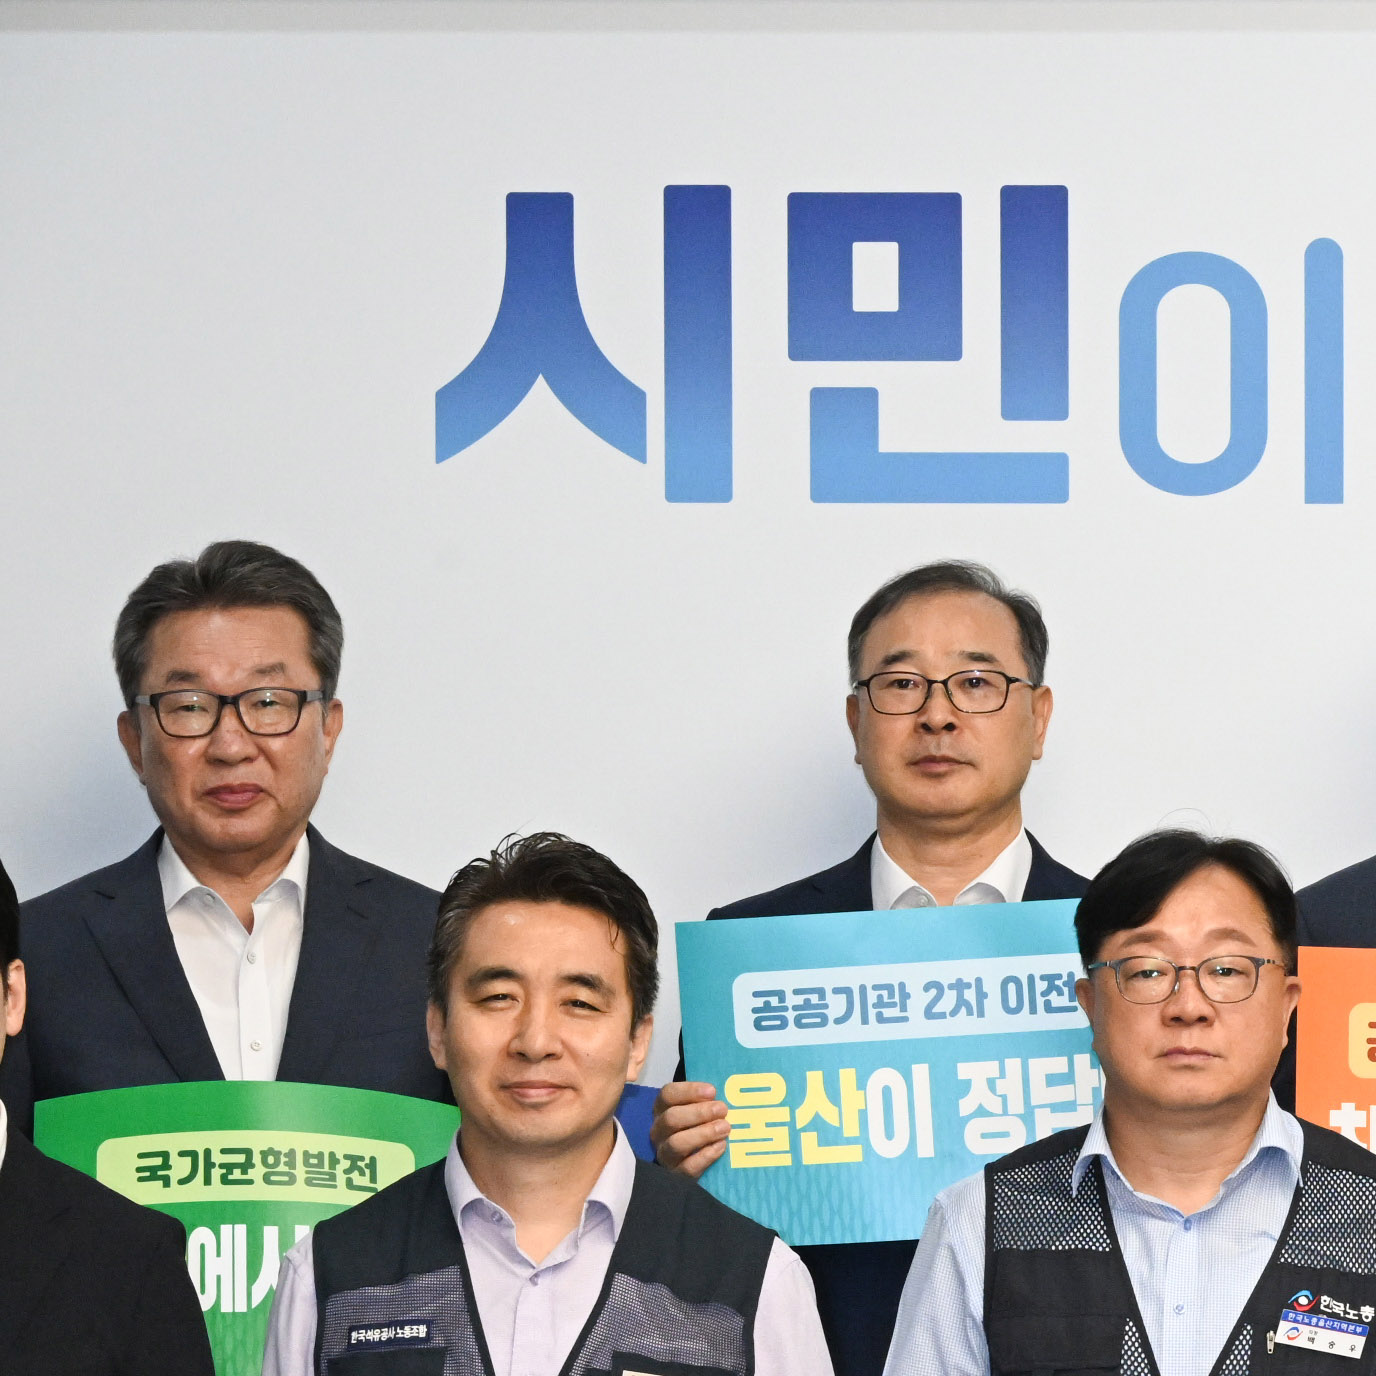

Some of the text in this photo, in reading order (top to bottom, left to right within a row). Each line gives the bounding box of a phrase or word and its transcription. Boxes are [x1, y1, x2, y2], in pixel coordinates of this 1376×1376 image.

[434, 184, 1344, 505] 시민이
[750, 971, 1079, 1032] 공공기관 2차 이전
[724, 1062, 935, 1169] 울산이
[134, 1146, 380, 1194] 국가균형발전
[350, 1324, 428, 1344] 한국석유공사 노동조합
[1319, 1294, 1376, 1323] 한국노총
